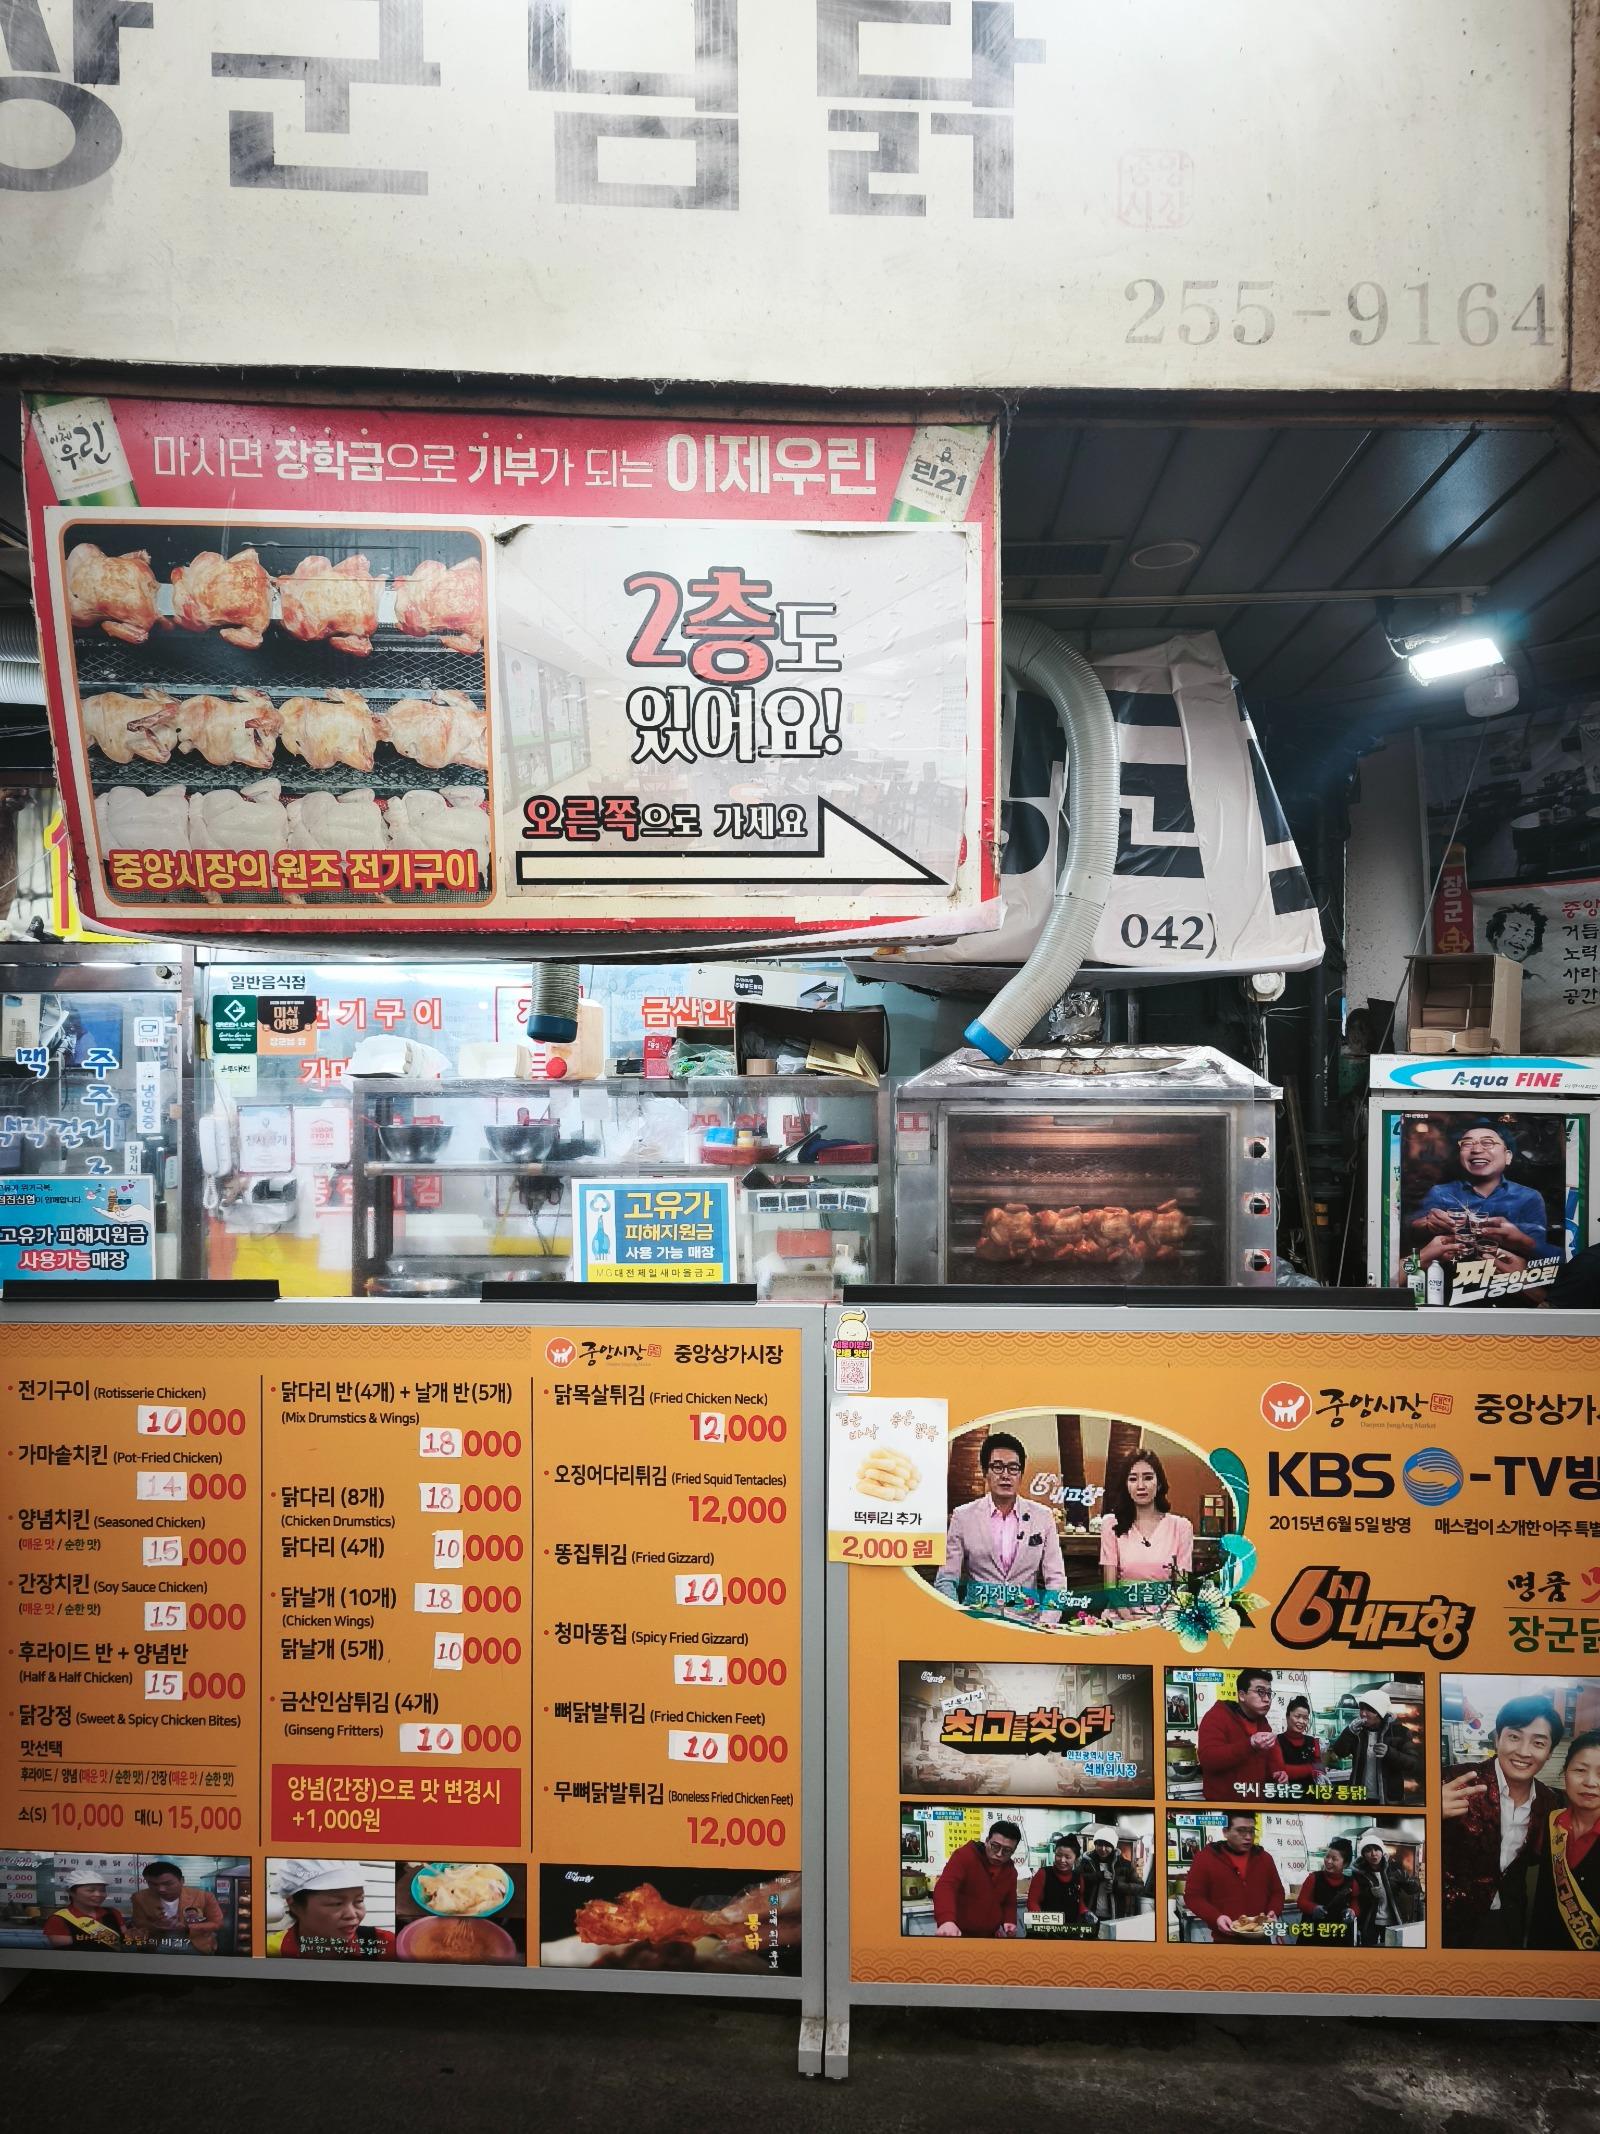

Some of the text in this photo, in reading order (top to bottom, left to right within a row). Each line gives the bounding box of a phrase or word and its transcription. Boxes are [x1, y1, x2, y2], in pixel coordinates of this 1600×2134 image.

[1124, 278, 1554, 348] 255-9164
[153, 436, 263, 478] 마시면
[274, 437, 457, 482] 장학금으로
[468, 444, 574, 487] 기부가
[585, 447, 653, 489] 되는
[667, 433, 877, 496] 이제우린
[624, 565, 843, 687] 2층도
[626, 685, 843, 764] 있어요!
[522, 794, 807, 842] 오른쪽으로 가세요
[109, 849, 480, 893] 중앙시장의 원조 전기구이
[1120, 913, 1219, 959] 042)
[230, 975, 306, 990] 일반음식점
[1451, 1071, 1509, 1088] Aqua
[1515, 1072, 1563, 1088] FINE
[624, 1190, 714, 1220] 고유가
[0, 1224, 148, 1246] 고유가 피해지원금
[625, 1223, 714, 1242] 피해지원금
[18, 1249, 128, 1270] 사용가능매장
[625, 1246, 715, 1260] 사용 가능 매장
[579, 1341, 784, 1366] 중앙시장 중앙상가시장
[18, 1379, 206, 1401] 전기구이 (Rotisserie Chicken)
[281, 1381, 449, 1403] 닭다리 날개
[554, 1384, 768, 1407] 닭목살튀김 (Fried Chicken Neck)
[281, 1411, 420, 1427] (Mix Drumstics Wings)
[1316, 1388, 1600, 1428] 중앙시장 중앙상가
[18, 1444, 223, 1466] 가마솥치킨 (Pot-Fried Chicken)
[554, 1464, 787, 1487] 오징어다리튀김 (Fried Squid Tentacles)
[1269, 1451, 1395, 1498] KBS
[281, 1486, 385, 1509] 닭다리 (8개)
[18, 1508, 206, 1531] 양념치킨 (Seasoned Chicken)
[688, 1495, 787, 1525] 12,000
[854, 1511, 922, 1526] 떡튀김 추가
[1269, 1515, 1573, 1537] 2015년 6월 5일 방영 매스컴이 소개한 아주
[281, 1536, 385, 1559] 닭다리 (4개)
[554, 1543, 715, 1566] 똥집튀김 (Fried Gizzard)
[842, 1536, 934, 1561] 2,000 원
[18, 1573, 208, 1595] 간장치킨 (Soy Sauce Chicken)
[1507, 1571, 1570, 1603] 명품
[281, 1586, 397, 1609] 닭날개 (10개)
[554, 1622, 749, 1646] 청마똥집 (Spicy Fried Gizzard)
[18, 1642, 189, 1665] 후라이드 반 양념반
[281, 1638, 384, 1661] 닭날개 (5개)
[19, 1671, 133, 1685] (Half Half Chicken)
[280, 1691, 439, 1715] 금산인삼튀김 (4개)
[554, 1702, 765, 1726] 뼈닭발튀김 (Fried Chicken Feet)
[19, 1704, 241, 1728] 닭강정 (Sweet Spicy Chicken Bites)
[940, 1704, 1116, 1745] 최고를 찾아라
[284, 1723, 384, 1739] (Ginseng Fritters)
[20, 1740, 63, 1758] 맛선택
[1084, 1763, 1137, 1777] 석바위시장
[288, 1776, 501, 1805] 양념(간장)으로 맛 변경시
[554, 1781, 794, 1807] 무뼈닭발튀김 (Boneless Fried Chicken Feet)
[1233, 1782, 1368, 1801] 역시 통닭은 시장 통닭!
[51, 1802, 242, 1834] 10,000 15,000
[292, 1808, 381, 1833] +1,000원
[687, 1817, 786, 1847] 12,000
[1262, 1922, 1349, 1939] 정말 6천 원??
